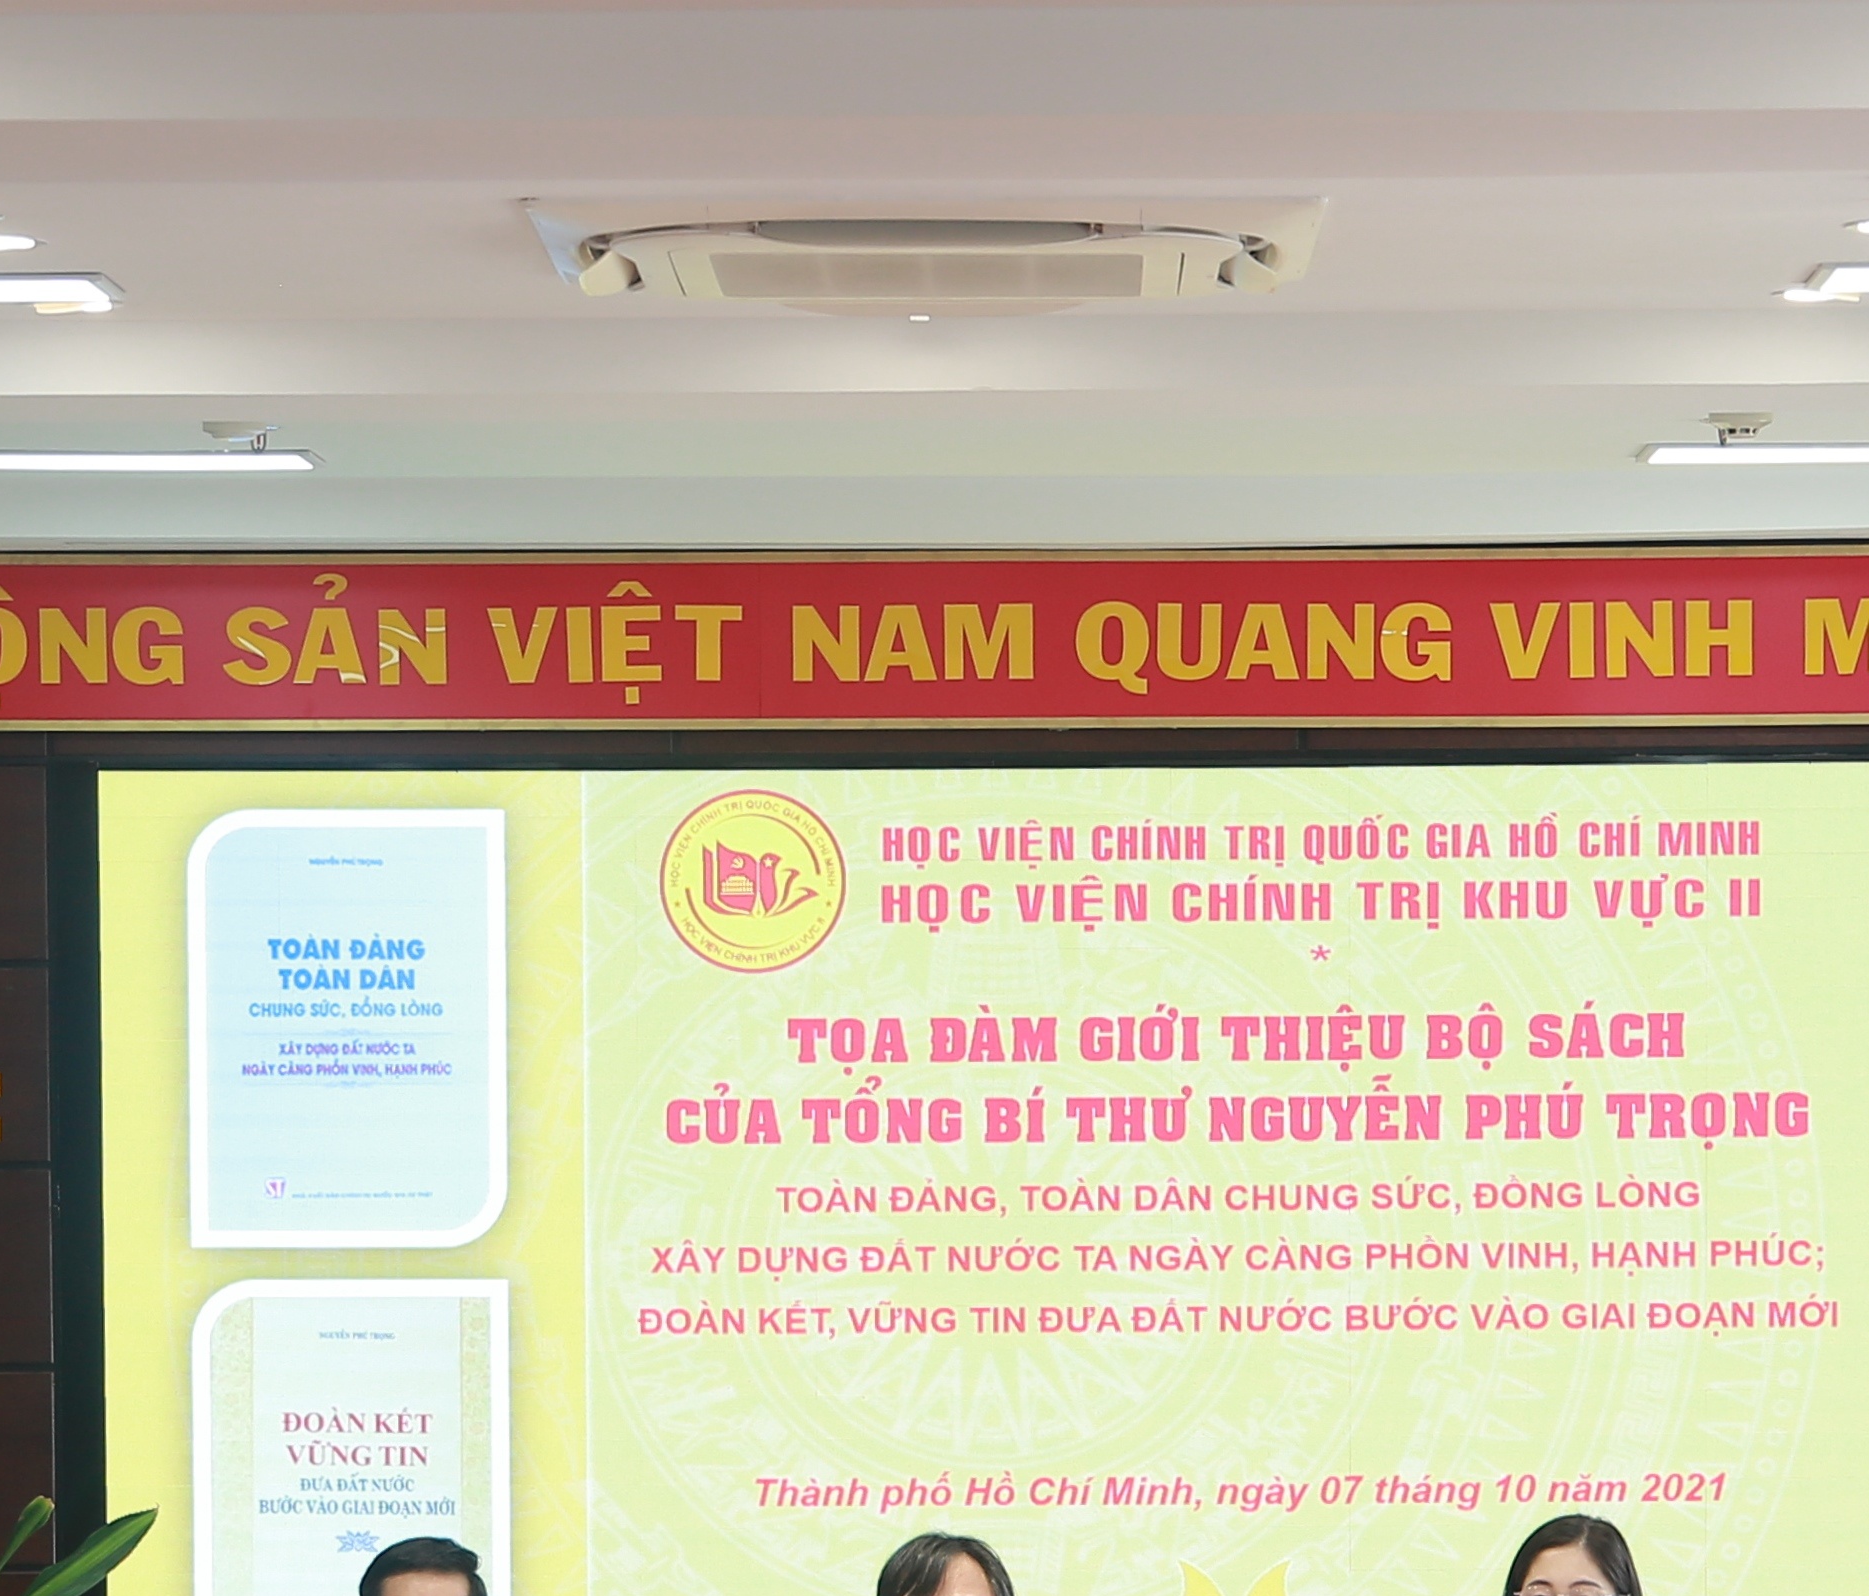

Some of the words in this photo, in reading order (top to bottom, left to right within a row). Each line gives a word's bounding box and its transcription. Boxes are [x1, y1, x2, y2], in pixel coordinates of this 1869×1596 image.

[223, 573, 447, 686] SẢN
[487, 581, 743, 705] VIỆT
[793, 604, 1033, 681] NAM
[1076, 602, 1451, 694] QUANG
[1490, 600, 1752, 678] VINH
[882, 826, 960, 869] HỌC
[978, 819, 1074, 870] VIỆN
[1091, 818, 1206, 862] CHÍNH
[1223, 825, 1285, 868] TRỊ
[1303, 814, 1409, 866] QUỐC
[1426, 822, 1491, 860] GIA
[1509, 812, 1558, 859] HỒ
[1579, 815, 1640, 858] CHÍ
[1658, 820, 1760, 857] MINH
[881, 883, 991, 933] HỌC
[1015, 874, 1148, 932] VIỆN
[1172, 874, 1331, 923] CHÍNH
[1356, 881, 1440, 930] TRỊ
[1463, 880, 1568, 920] KHU
[1593, 873, 1705, 928] VỰC
[1729, 878, 1761, 917] II
[268, 933, 341, 961] TOÀN
[348, 933, 426, 961] ĐẢNG
[278, 964, 351, 991] TOÀN
[360, 965, 415, 991] DÂN
[249, 1003, 306, 1018] CHUNG
[311, 998, 346, 1019] SỨC,
[351, 996, 397, 1018] ĐỒNG
[401, 999, 444, 1018] LÒNG
[787, 1017, 909, 1076] TỌA
[929, 1004, 1058, 1063] ĐÀM
[1079, 1003, 1200, 1062] GIỚI
[1220, 1003, 1406, 1073] THIỆU
[1426, 1002, 1503, 1071] BỘ
[1528, 1000, 1685, 1059] SÁCH
[666, 1082, 782, 1145] CỦA
[801, 1077, 962, 1144] TỔNG
[984, 1085, 1045, 1143] BÍ
[1065, 1085, 1193, 1143] THƯ
[1208, 1074, 1442, 1142] NGUYỄN
[1465, 1081, 1584, 1140] PHÚ
[1605, 1091, 1809, 1150] TRỌNG
[775, 1178, 877, 1214] TOÀN
[887, 1178, 1007, 1218] ĐẢNG,
[1019, 1177, 1121, 1212] TOÀN
[1134, 1176, 1212, 1212] DÂN
[1224, 1183, 1359, 1212] CHUNG
[1371, 1175, 1462, 1215] SỨC,
[1472, 1174, 1583, 1210] ĐỒNG
[1596, 1173, 1700, 1209] LÒNG
[651, 1239, 726, 1274] XÂY
[738, 1246, 848, 1282] DỰNG
[858, 1238, 937, 1273] ĐẤT
[947, 1237, 1061, 1273] NƯỚC
[1073, 1244, 1118, 1272] TA
[1129, 1236, 1234, 1272] NGÀY
[1245, 1236, 1352, 1272] CÀNG
[1365, 1234, 1469, 1270] PHỒN
[1481, 1241, 1579, 1274] VINH,
[1591, 1240, 1696, 1277] HẠNH
[1710, 1231, 1824, 1272] PHÚC;
[637, 1300, 745, 1335] ĐOÀN
[758, 1300, 836, 1340] KẾT,
[847, 1300, 957, 1334] VỮNG
[969, 1306, 1026, 1334] TIN
[1037, 1306, 1122, 1334] ĐƯA
[1130, 1298, 1209, 1333] ĐẤT
[1219, 1297, 1332, 1333] NƯỚC
[1345, 1296, 1458, 1333] BƯỚC
[1470, 1295, 1550, 1331] VÀO
[1561, 1302, 1636, 1330] GIAI
[1646, 1301, 1755, 1337] ĐOẠN
[1768, 1293, 1838, 1329] MỚI
[282, 1406, 365, 1433] ĐOÀN
[375, 1406, 433, 1434] KẾT
[286, 1440, 371, 1467] VỮNG
[379, 1446, 429, 1467] TIN
[755, 1477, 869, 1507] Thành
[879, 1470, 953, 1515] phố
[964, 1470, 1016, 1507] Hồ
[1029, 1476, 1094, 1506] Chí
[1102, 1476, 1202, 1511] Minh,
[1216, 1475, 1310, 1513] ngày
[1319, 1474, 1365, 1505] 07
[1375, 1474, 1482, 1512] tháng
[1495, 1473, 1537, 1503] 10
[1547, 1473, 1628, 1503] năm
[1640, 1472, 1726, 1502] 2021
